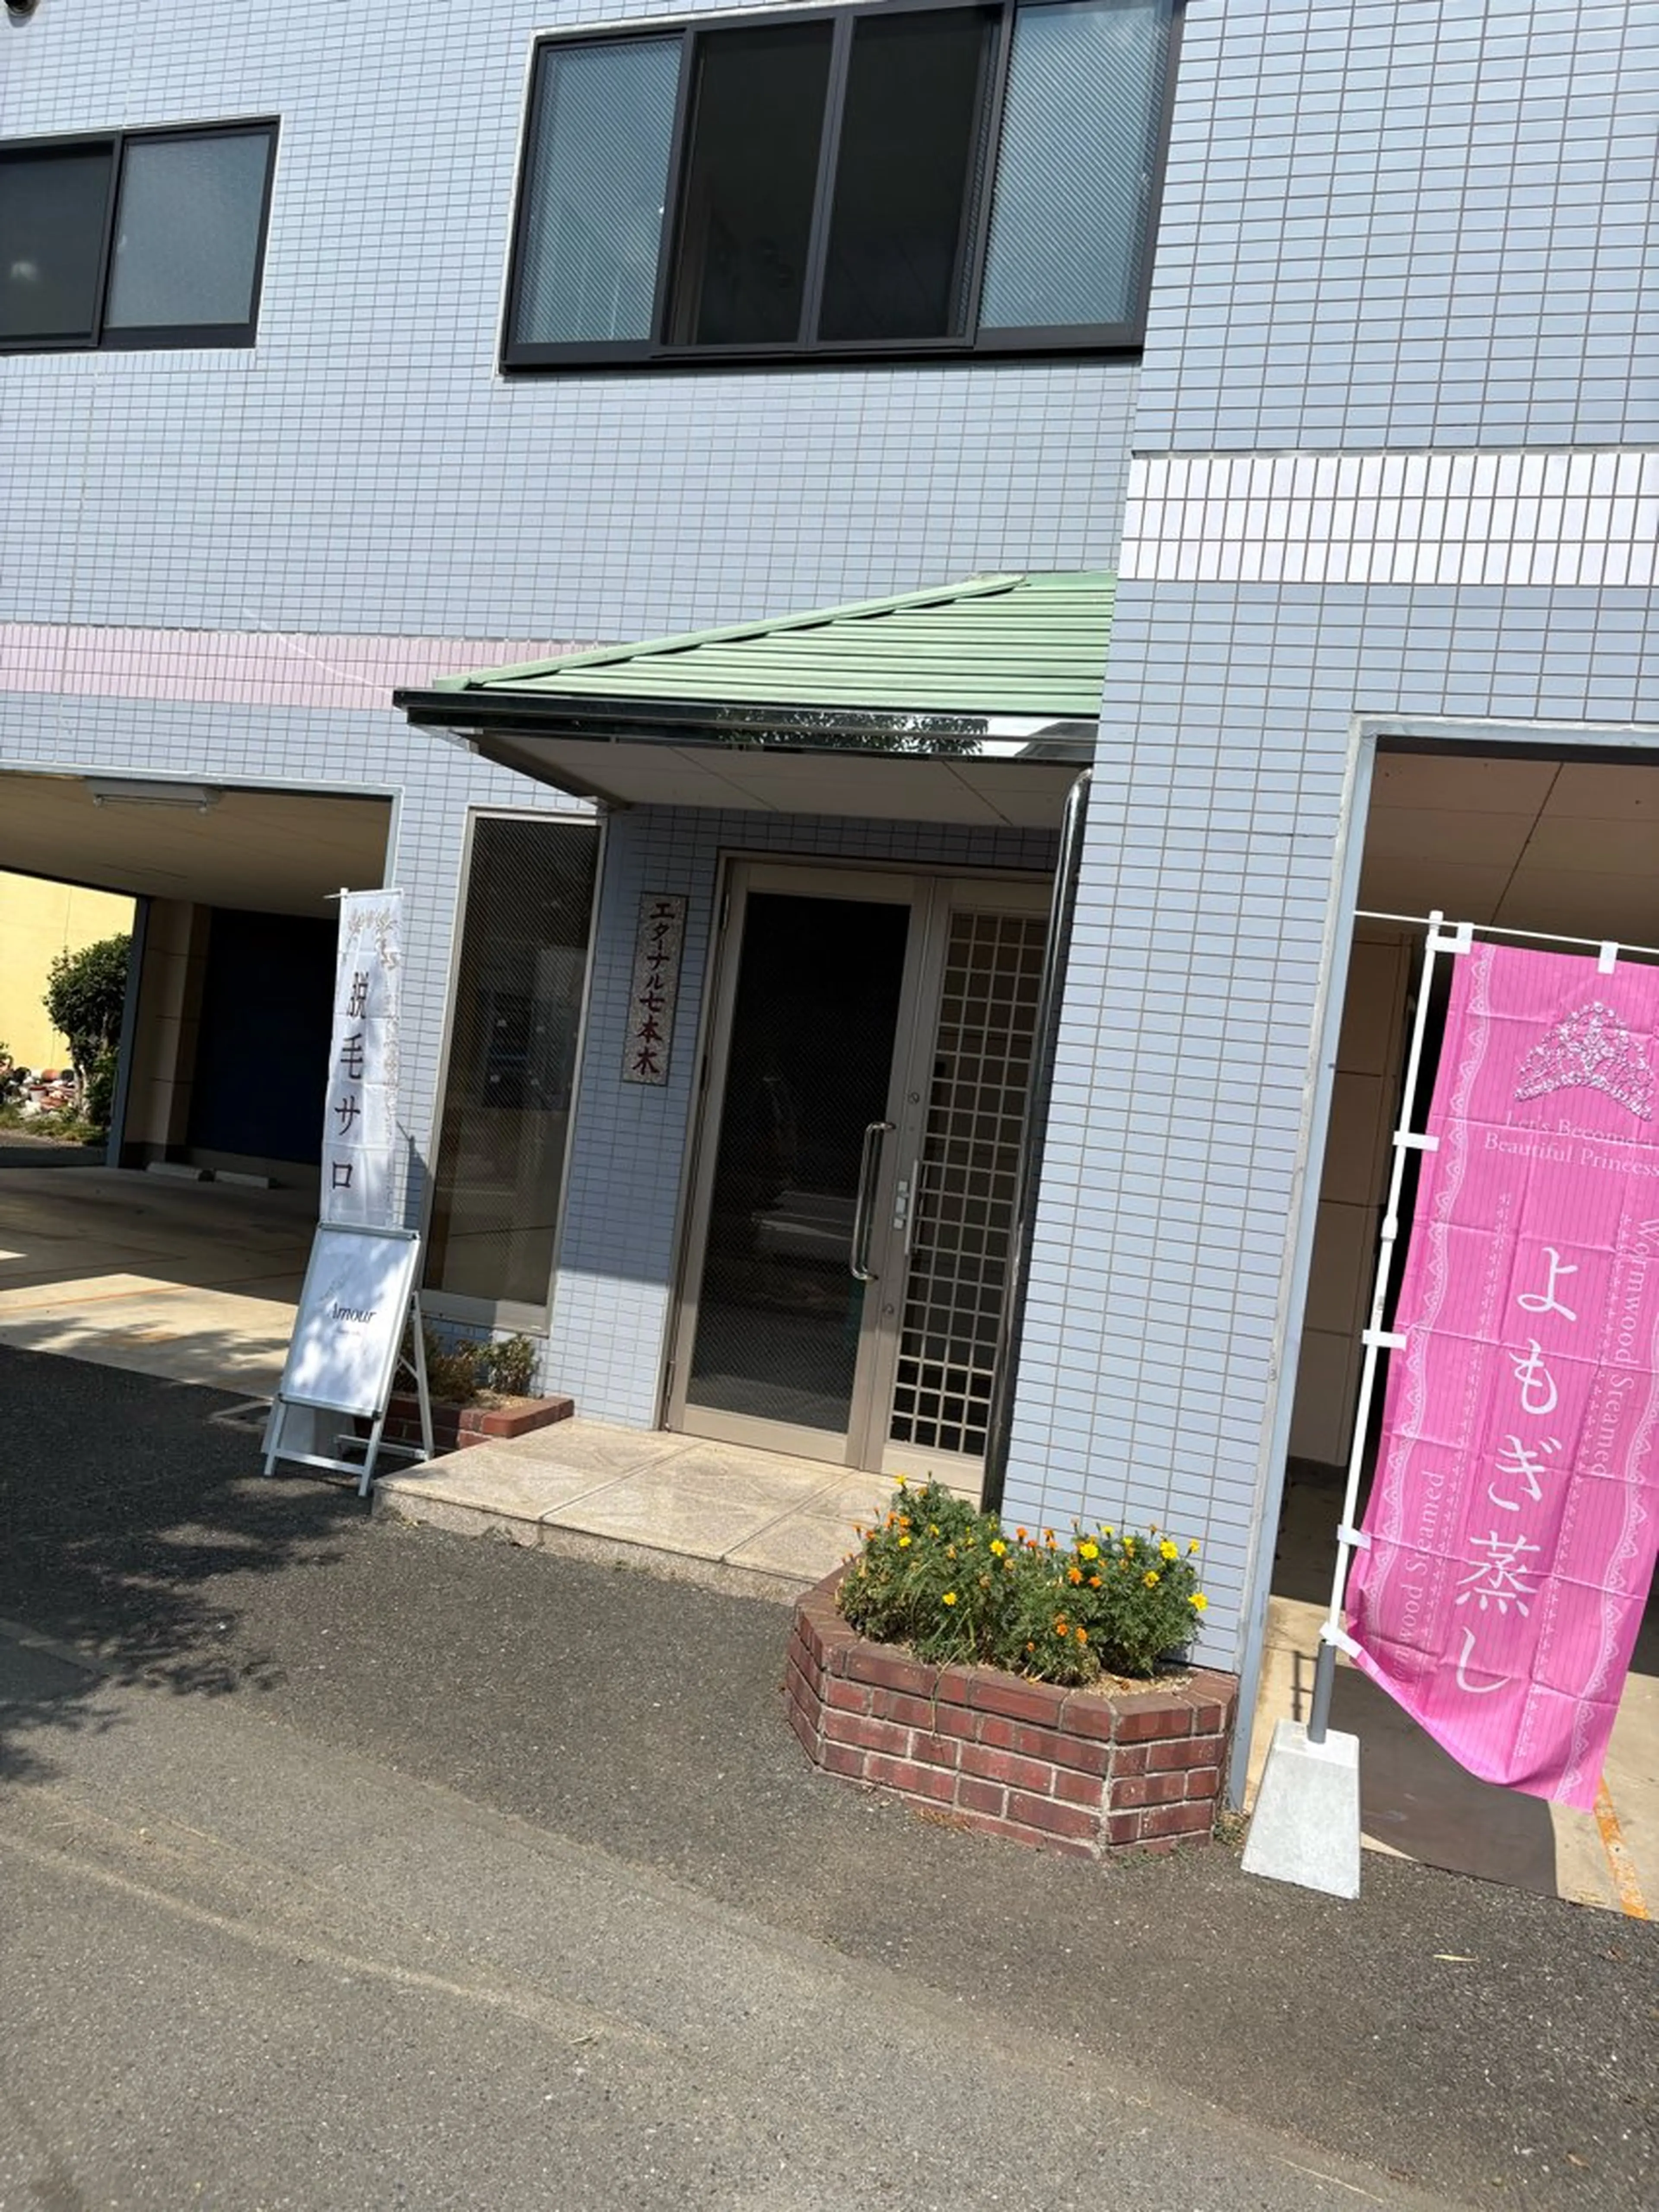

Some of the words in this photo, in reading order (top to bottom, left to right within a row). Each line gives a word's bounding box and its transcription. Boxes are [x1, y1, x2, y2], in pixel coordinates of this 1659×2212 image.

[632, 902, 675, 1075] エターナル七本木
[1484, 1132, 1573, 1163] Beautiful
[327, 1302, 377, 1324] Amour
[1454, 1246, 1579, 1694] よもぎ蒸し
[1592, 1373, 1635, 1478] Steamed
[1405, 1470, 1445, 1576] Steamed
